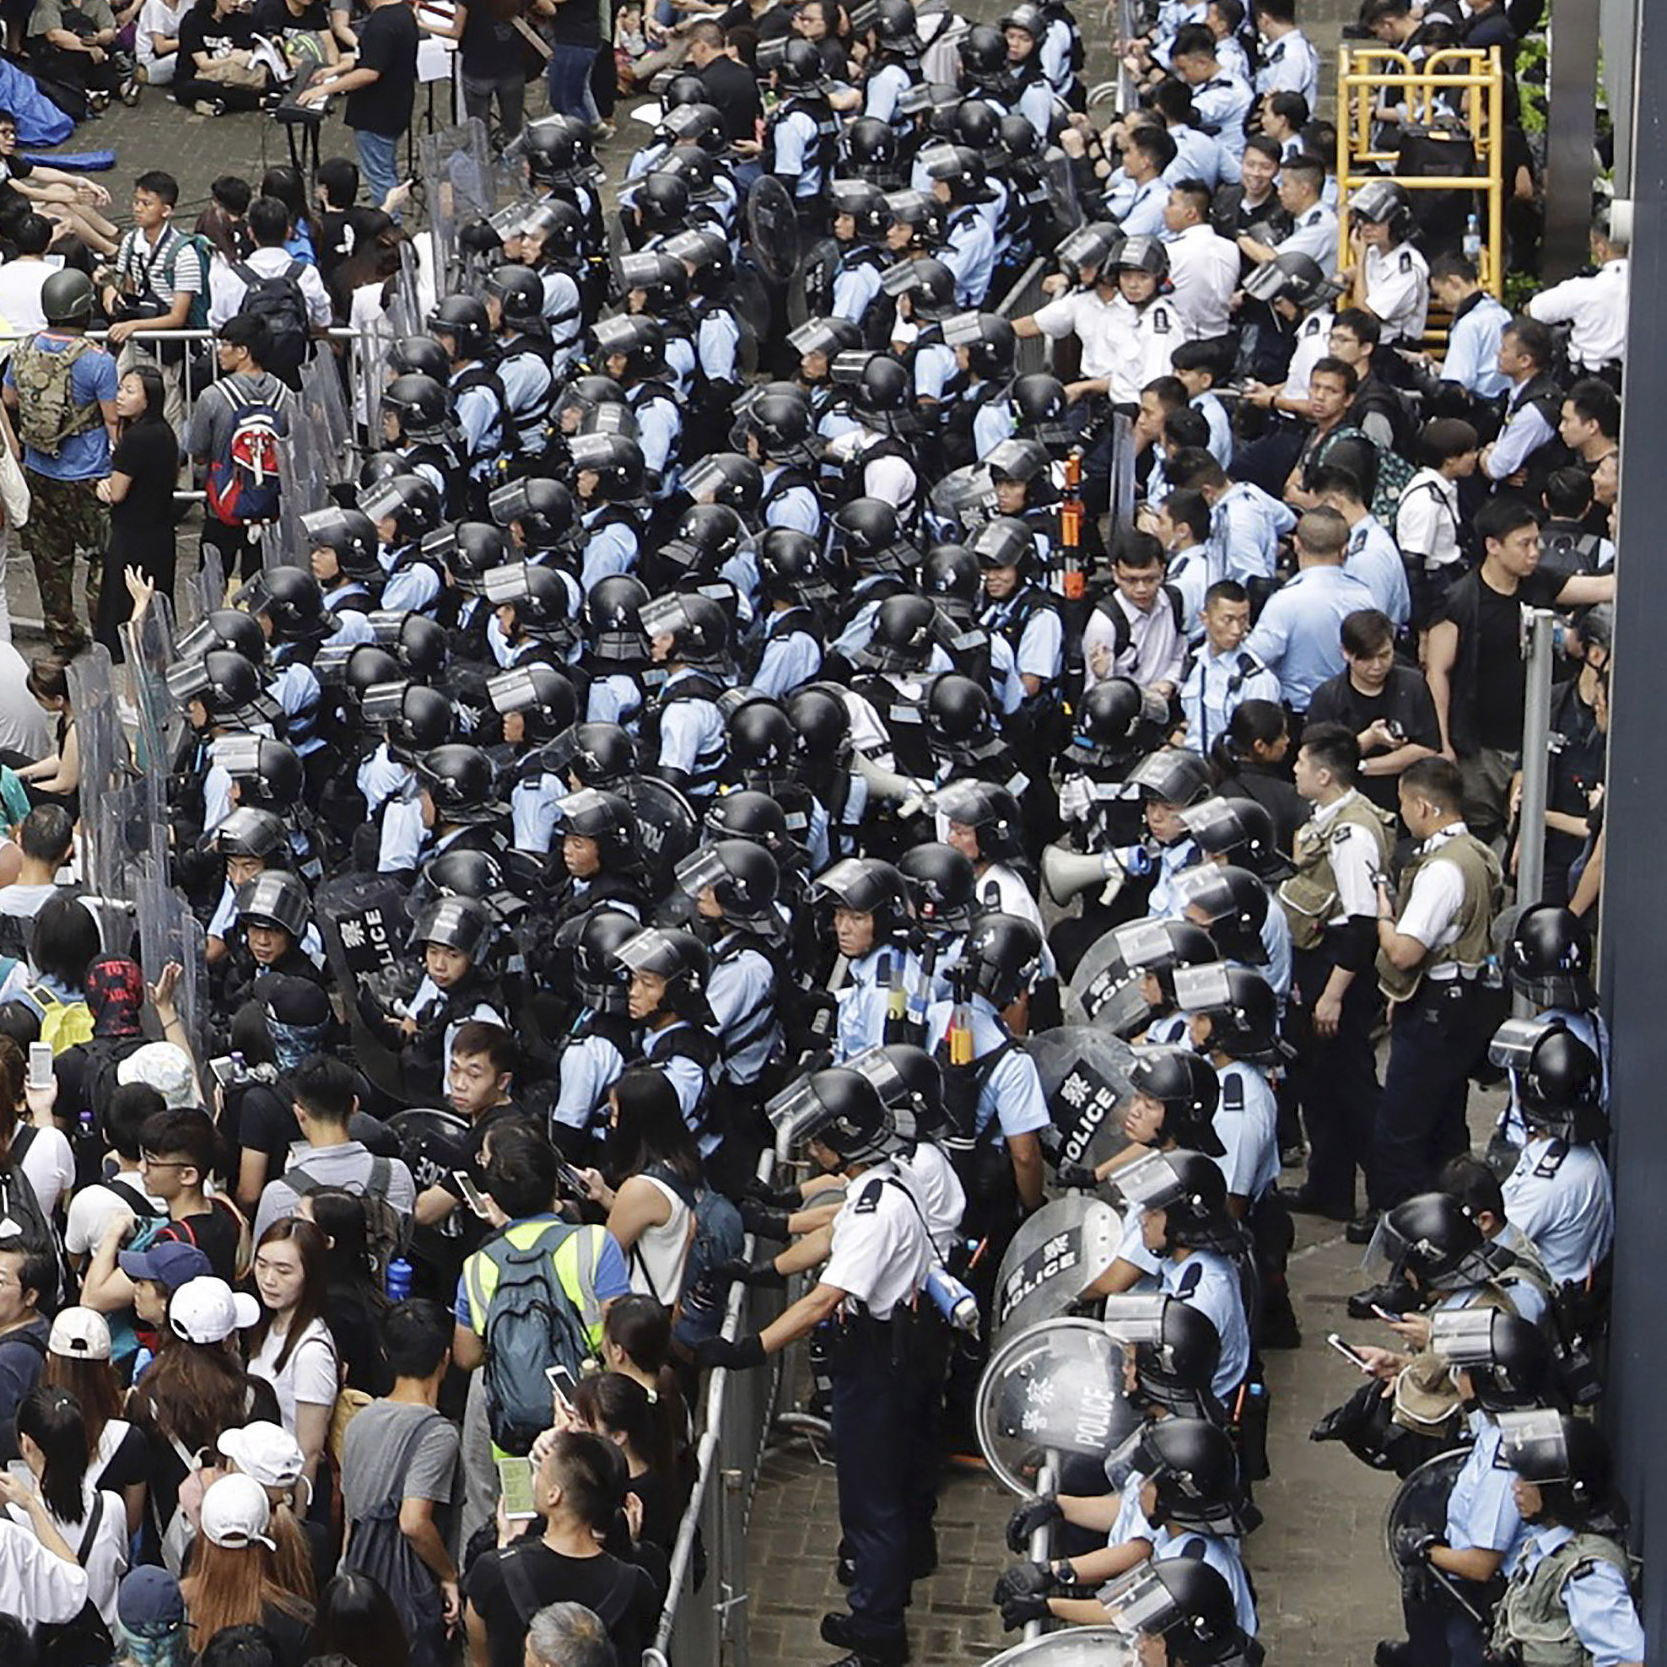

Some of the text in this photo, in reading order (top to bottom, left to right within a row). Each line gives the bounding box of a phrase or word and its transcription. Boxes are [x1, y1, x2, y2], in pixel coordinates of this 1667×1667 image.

[365, 909, 401, 981] OLICE
[1091, 966, 1147, 1015] POLIC
[1064, 1086, 1116, 1170] OLICE
[1075, 1385, 1115, 1448] POLICE
